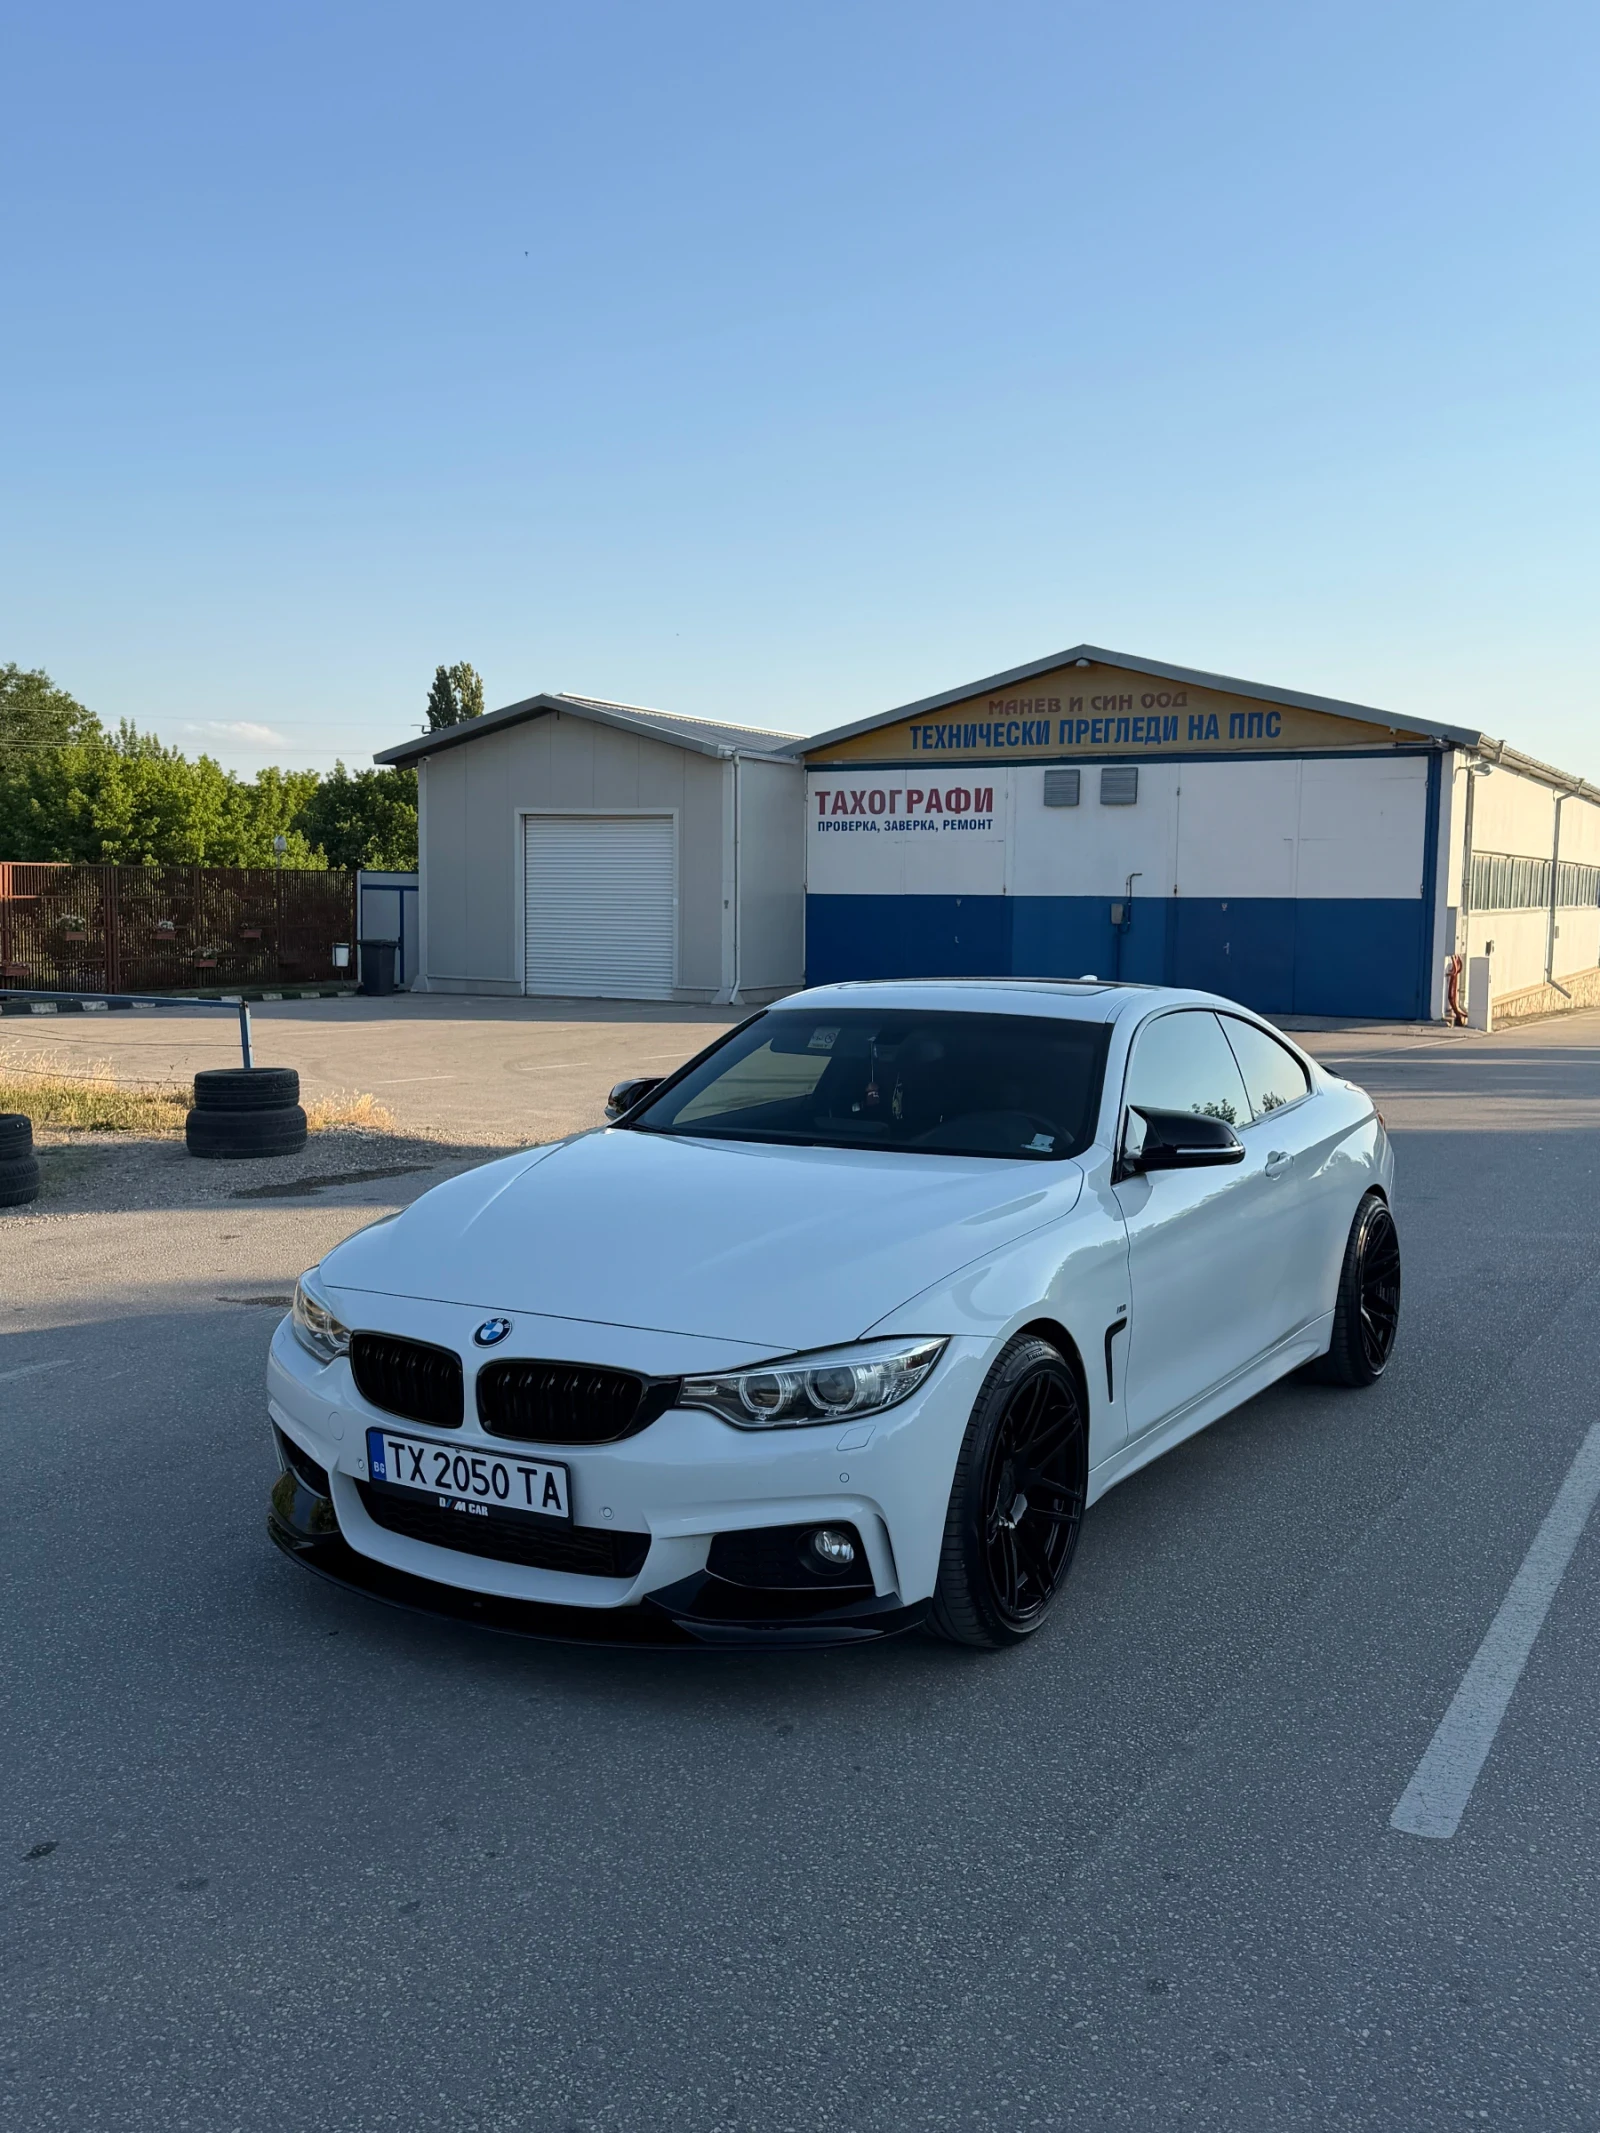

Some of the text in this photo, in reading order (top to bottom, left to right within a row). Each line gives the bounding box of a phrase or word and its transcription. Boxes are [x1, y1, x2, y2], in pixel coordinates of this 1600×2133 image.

[988, 692, 1188, 715] МАНЕВ И СИН ООД
[910, 711, 1281, 749] ТЕХНИЧЕСКИ ПРЕГЛЕДИ НА ППС
[815, 787, 993, 815] ТАХОГРАФИ
[818, 819, 993, 833] ПРОВЕРКА, ЗАВЕРКА, РЕМОНТ
[374, 1461, 385, 1474] BG
[388, 1441, 562, 1511] TX 2050 TA
[468, 1503, 488, 1516] CAR
